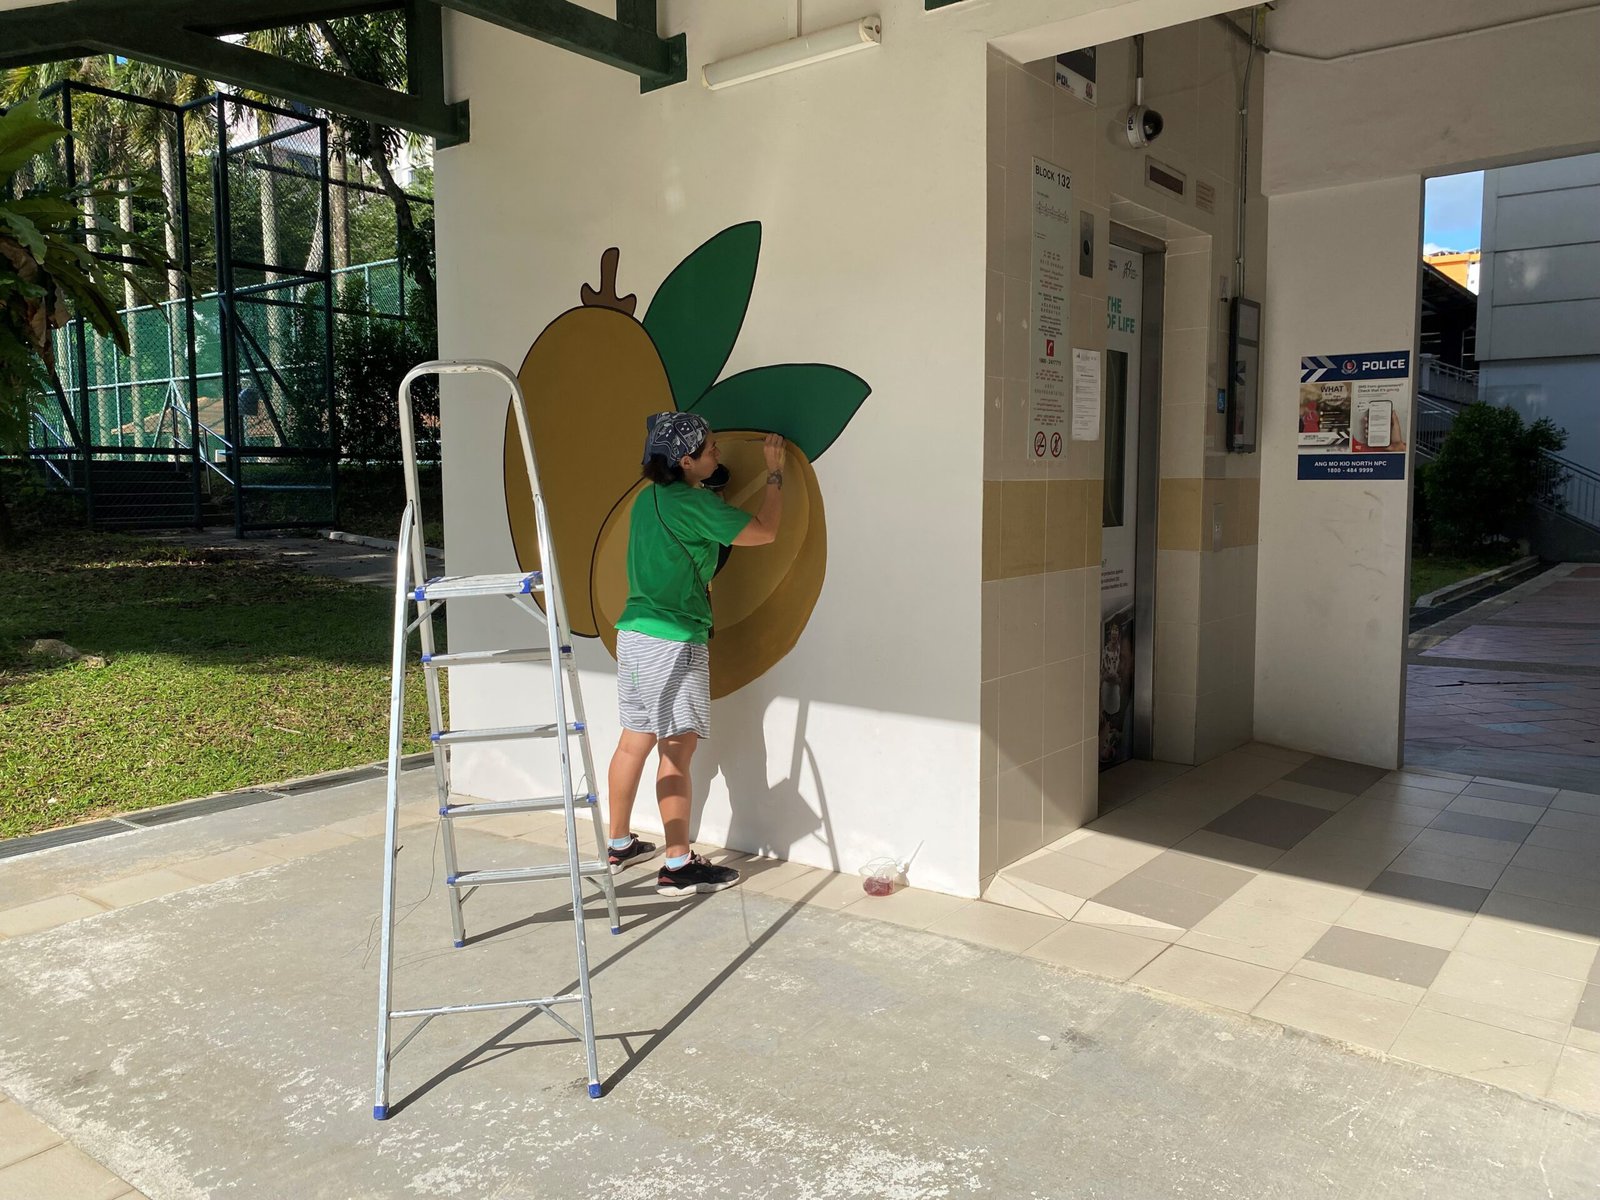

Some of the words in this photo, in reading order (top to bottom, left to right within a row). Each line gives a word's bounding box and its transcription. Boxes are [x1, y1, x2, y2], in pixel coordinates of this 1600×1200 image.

[1035, 164, 1055, 182] BLOCK
[1057, 172, 1071, 190] 132
[1118, 315, 1135, 334] LIFE
[1362, 359, 1406, 371] POLICE
[1320, 385, 1344, 393] WHAT
